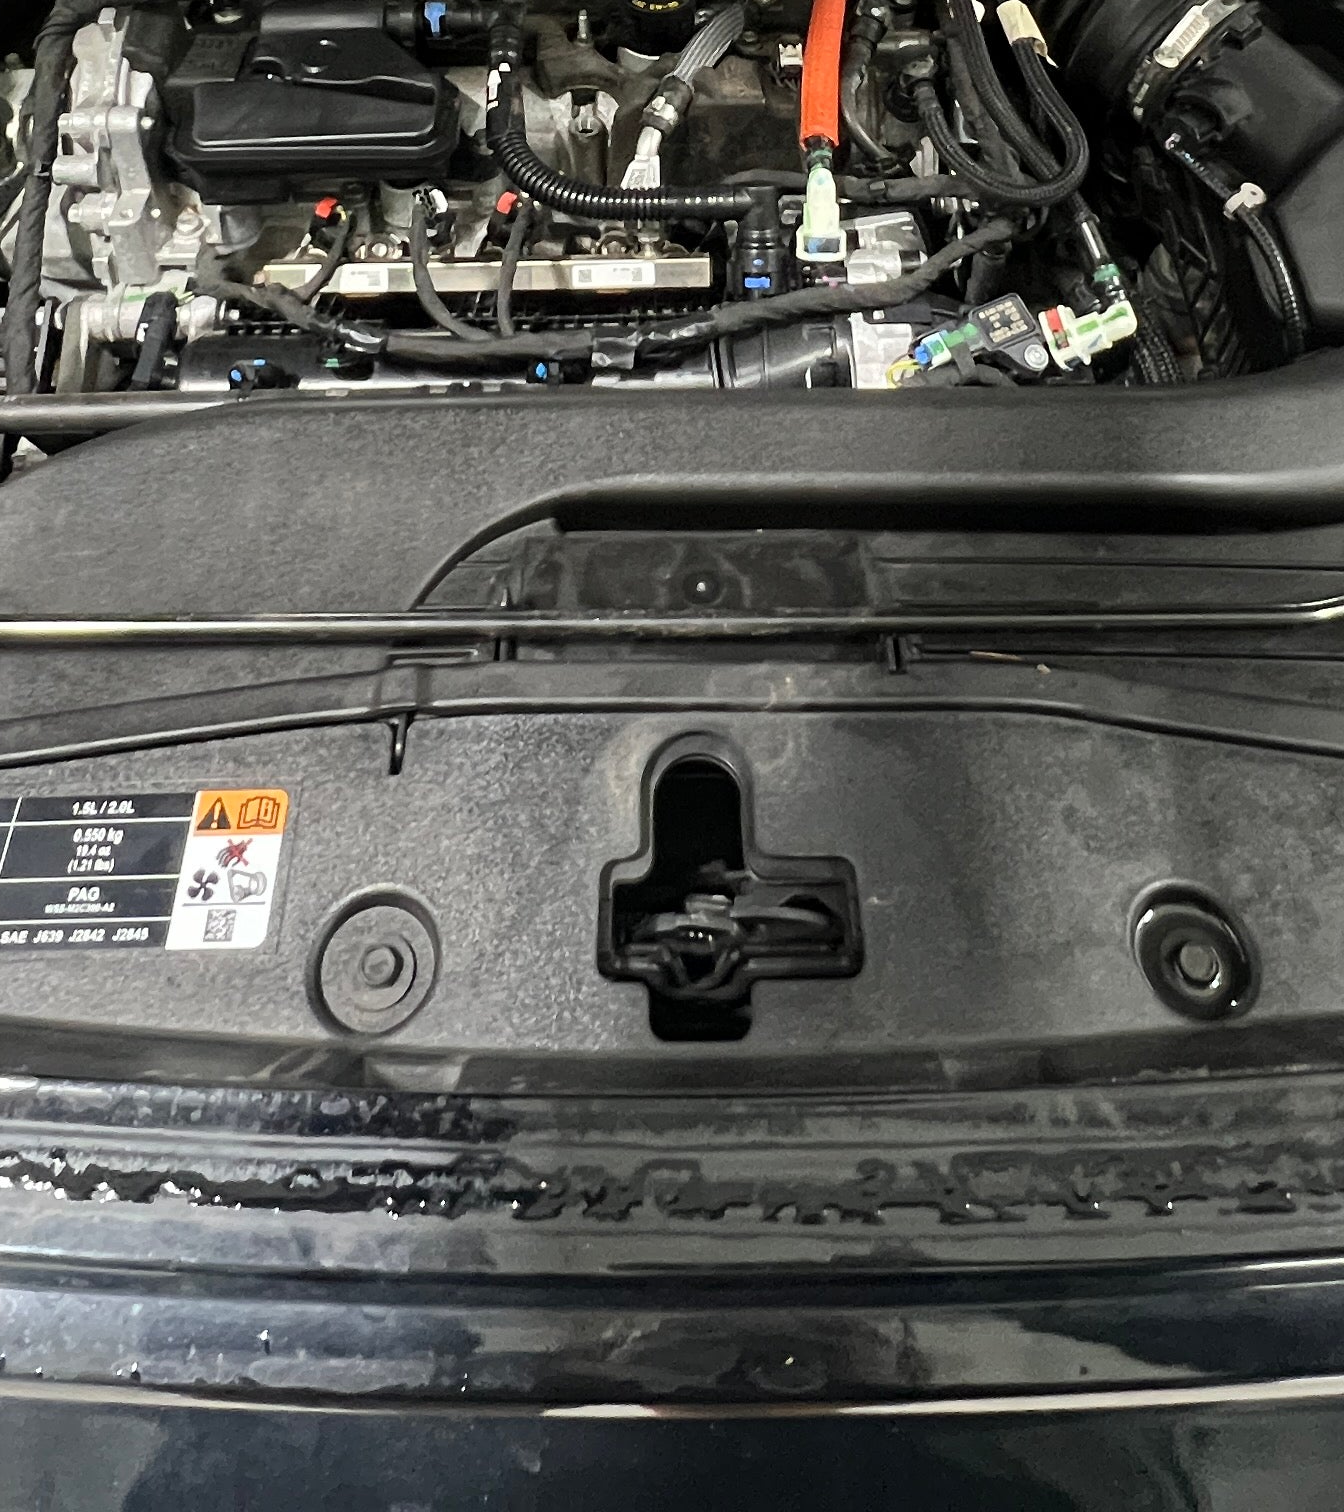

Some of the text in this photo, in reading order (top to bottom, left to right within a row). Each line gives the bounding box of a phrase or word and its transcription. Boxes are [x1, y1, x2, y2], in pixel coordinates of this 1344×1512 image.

[107, 827, 124, 845] kg
[67, 887, 100, 902] PAG
[0, 930, 29, 944] SAE
